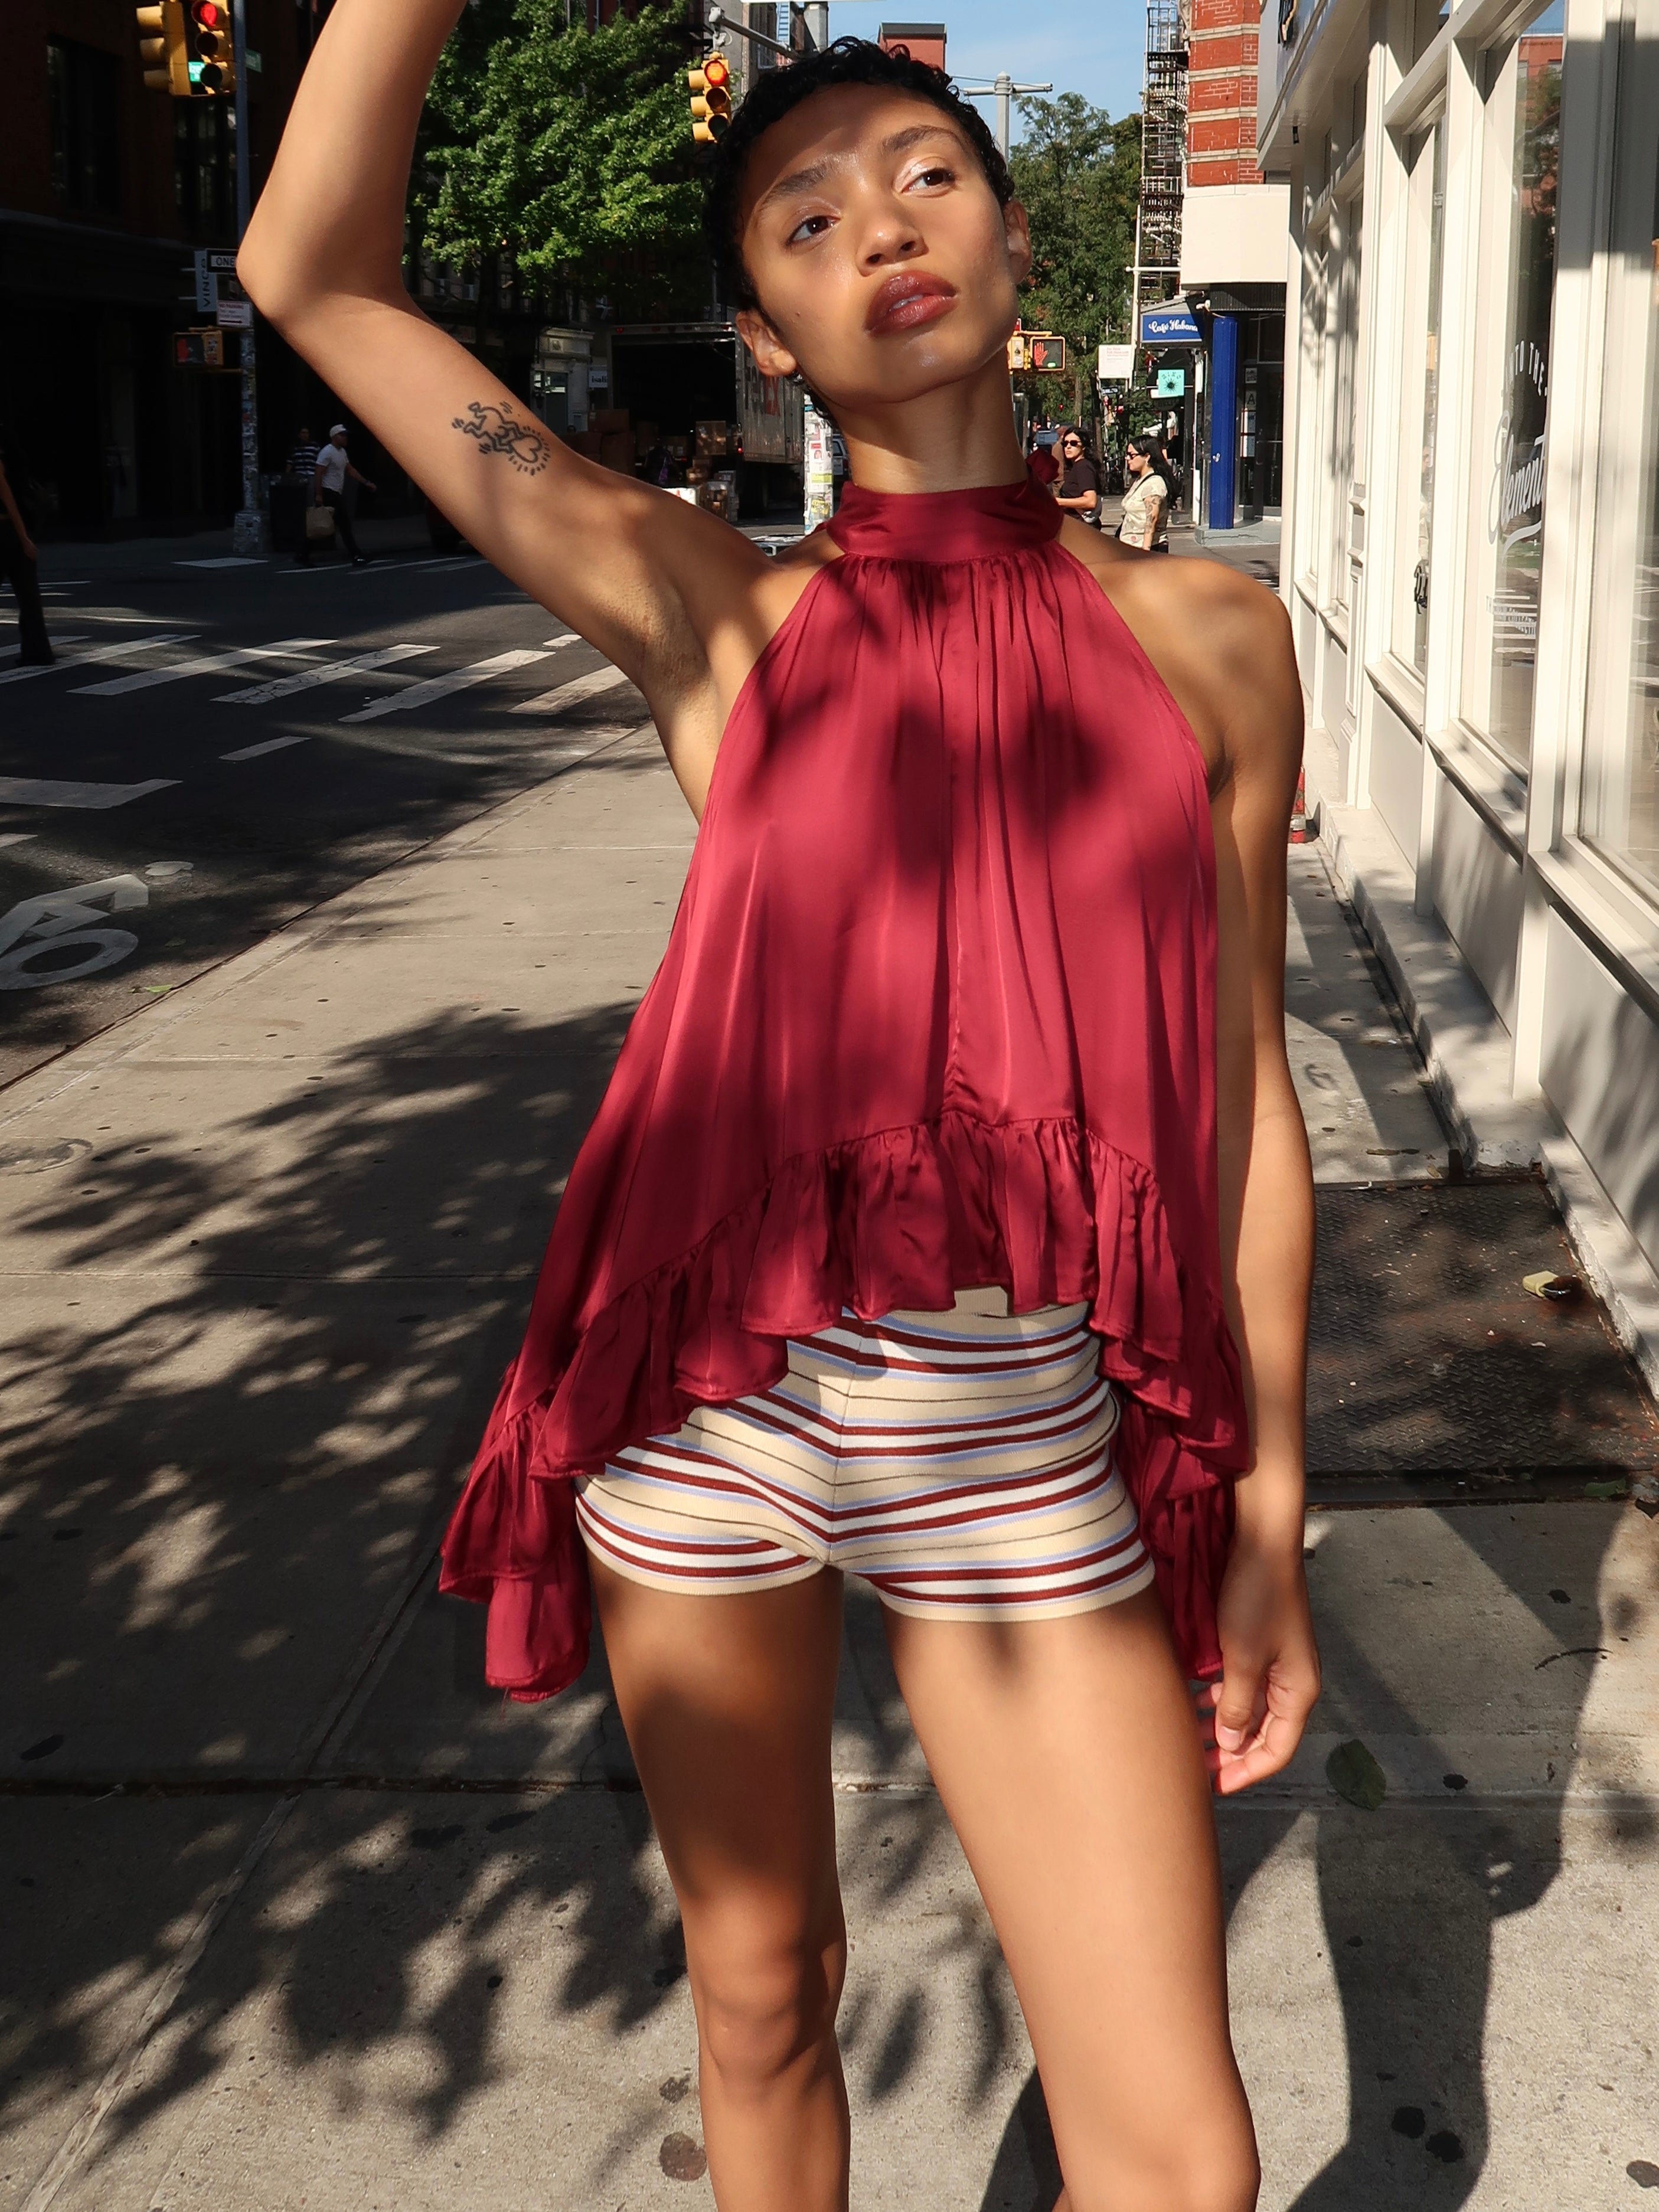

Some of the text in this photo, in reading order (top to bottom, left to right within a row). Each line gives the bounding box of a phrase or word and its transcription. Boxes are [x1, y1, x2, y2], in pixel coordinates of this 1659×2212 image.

[216, 256, 235, 266] ONE
[1528, 342, 1544, 396] THE
[1247, 393, 1255, 404] A
